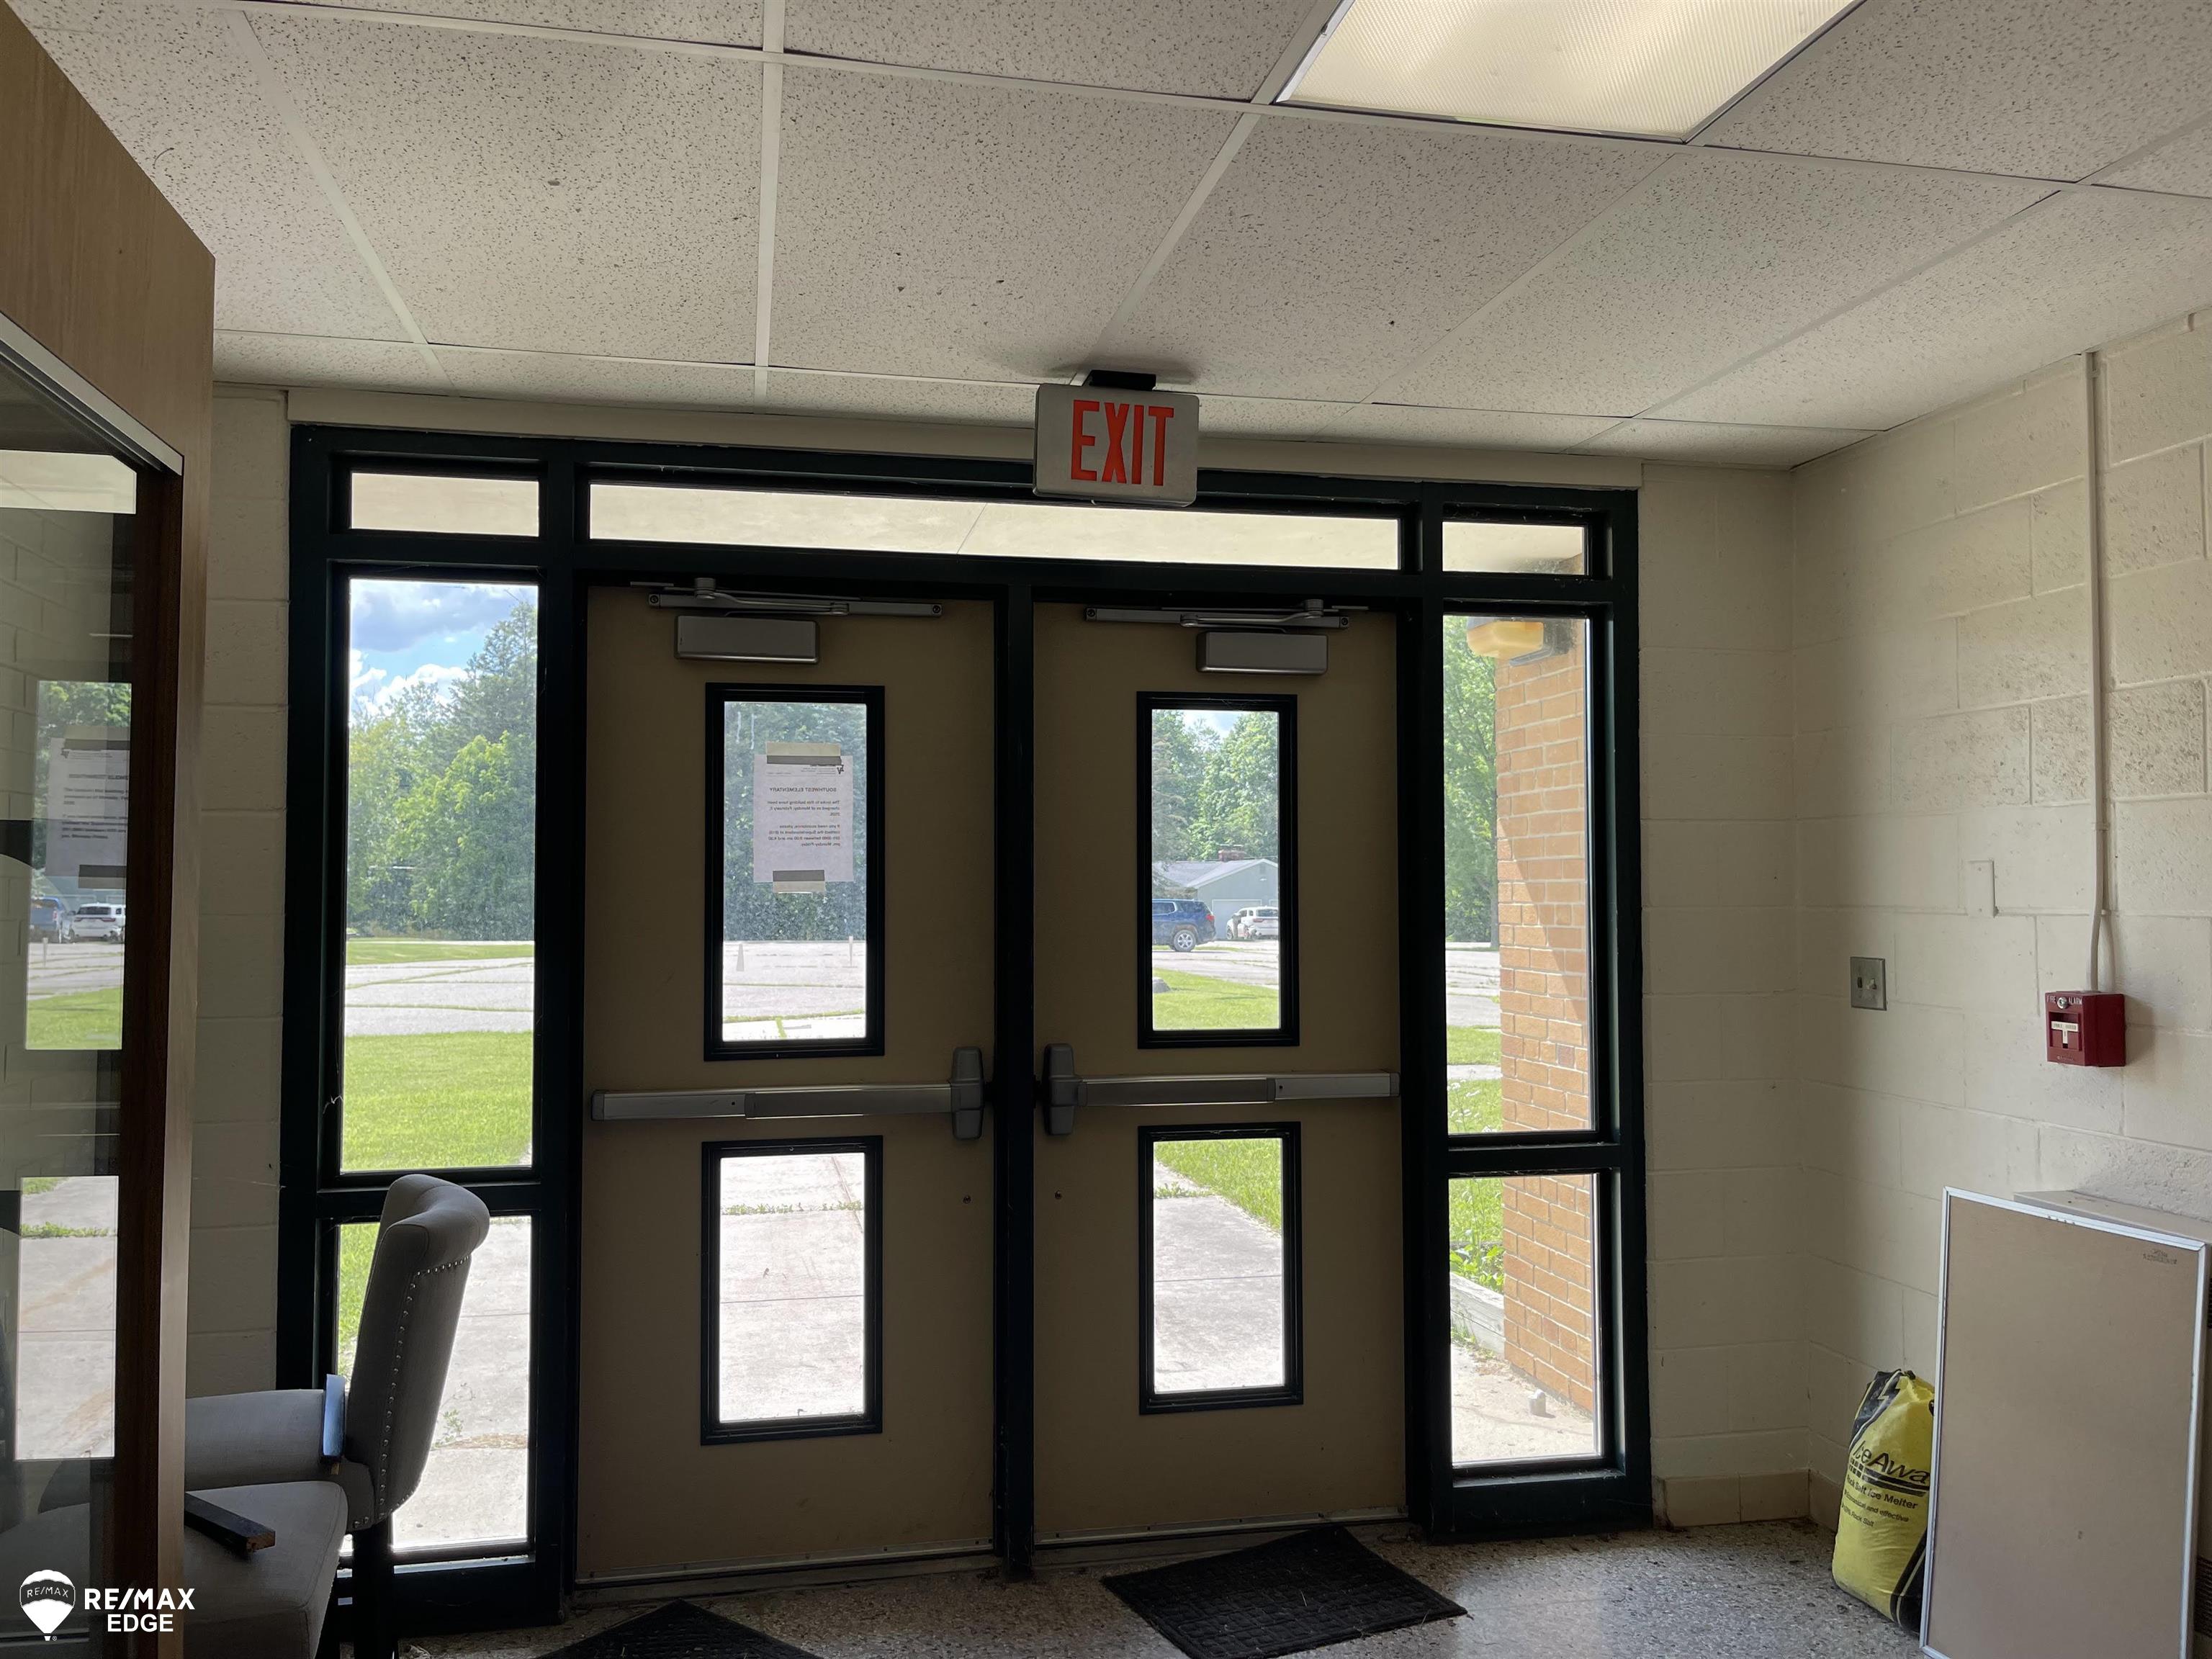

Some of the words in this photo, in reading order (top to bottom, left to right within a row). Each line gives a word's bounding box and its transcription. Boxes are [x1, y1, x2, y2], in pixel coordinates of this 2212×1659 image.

[1071, 400, 1174, 486] EXIT
[2068, 996, 2082, 1004] ALARM
[1853, 1440, 1930, 1484] IceAwa
[1855, 1481, 1867, 1495] Salt
[1884, 1493, 1918, 1509] Melter
[1863, 1517, 1875, 1527] Salt
[1879, 1509, 1910, 1522] effective
